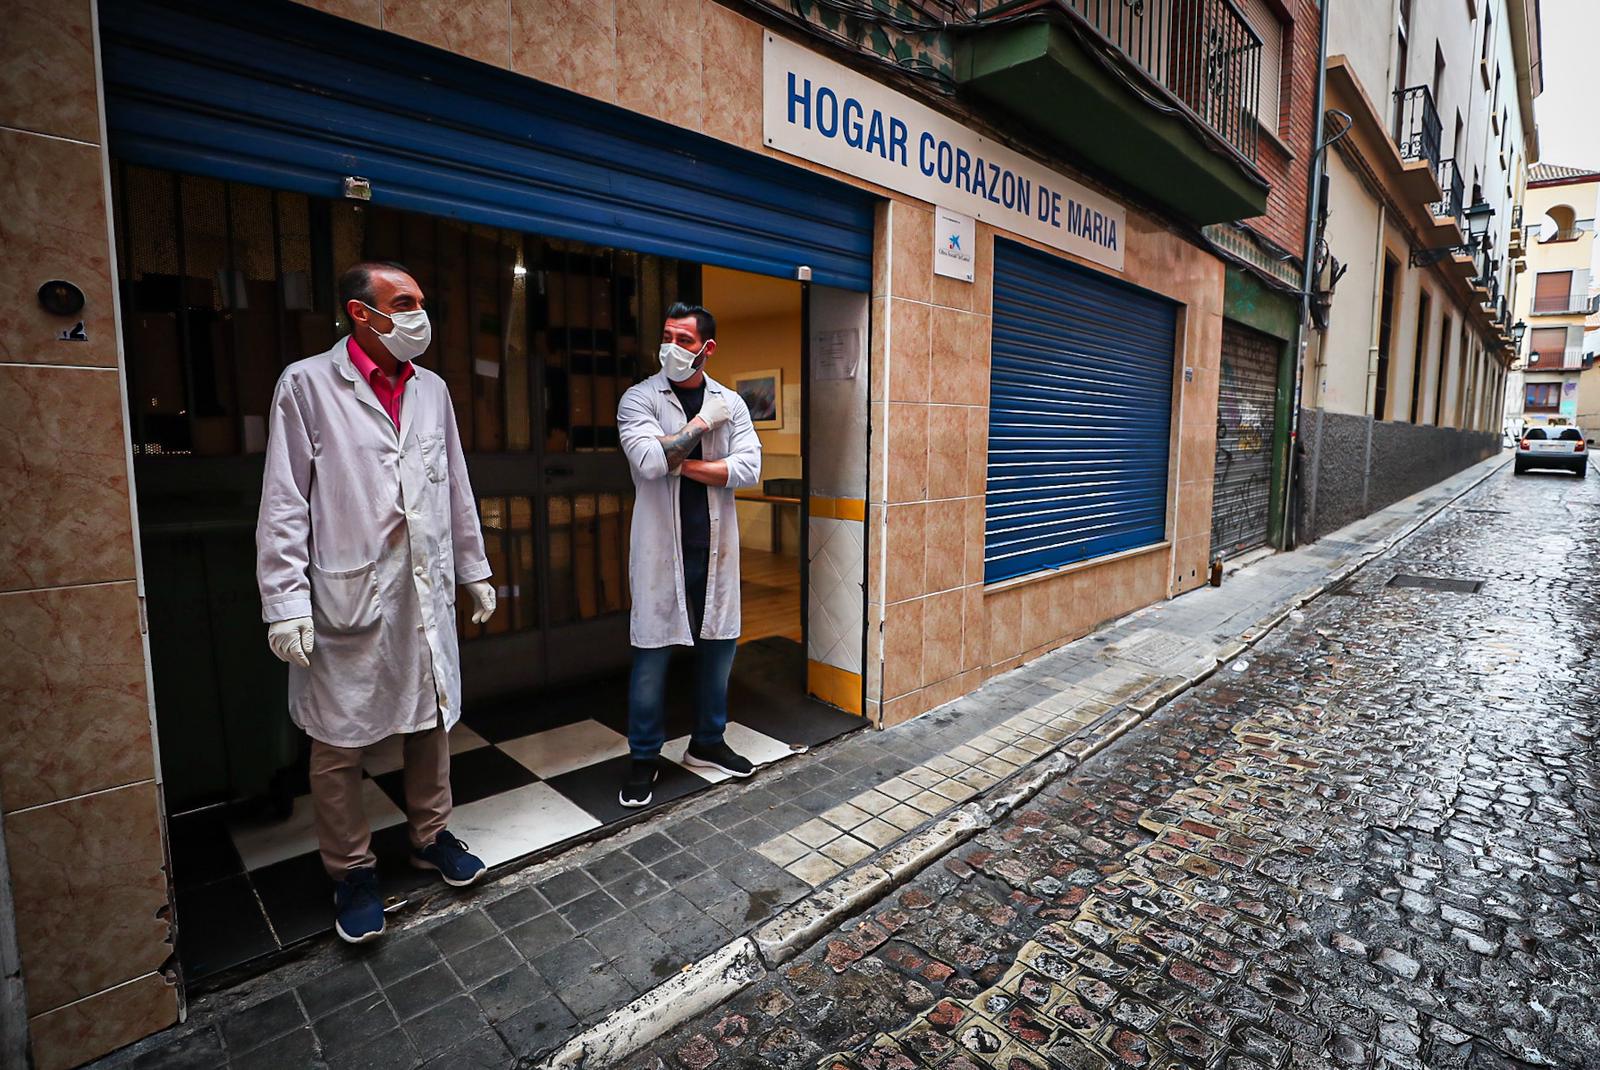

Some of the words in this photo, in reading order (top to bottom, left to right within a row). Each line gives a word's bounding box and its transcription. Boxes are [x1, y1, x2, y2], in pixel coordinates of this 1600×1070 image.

[788, 72, 908, 167] HOGAR
[919, 131, 1030, 215] CORAZON
[1038, 186, 1060, 228] DE
[1068, 200, 1117, 251] MARIA
